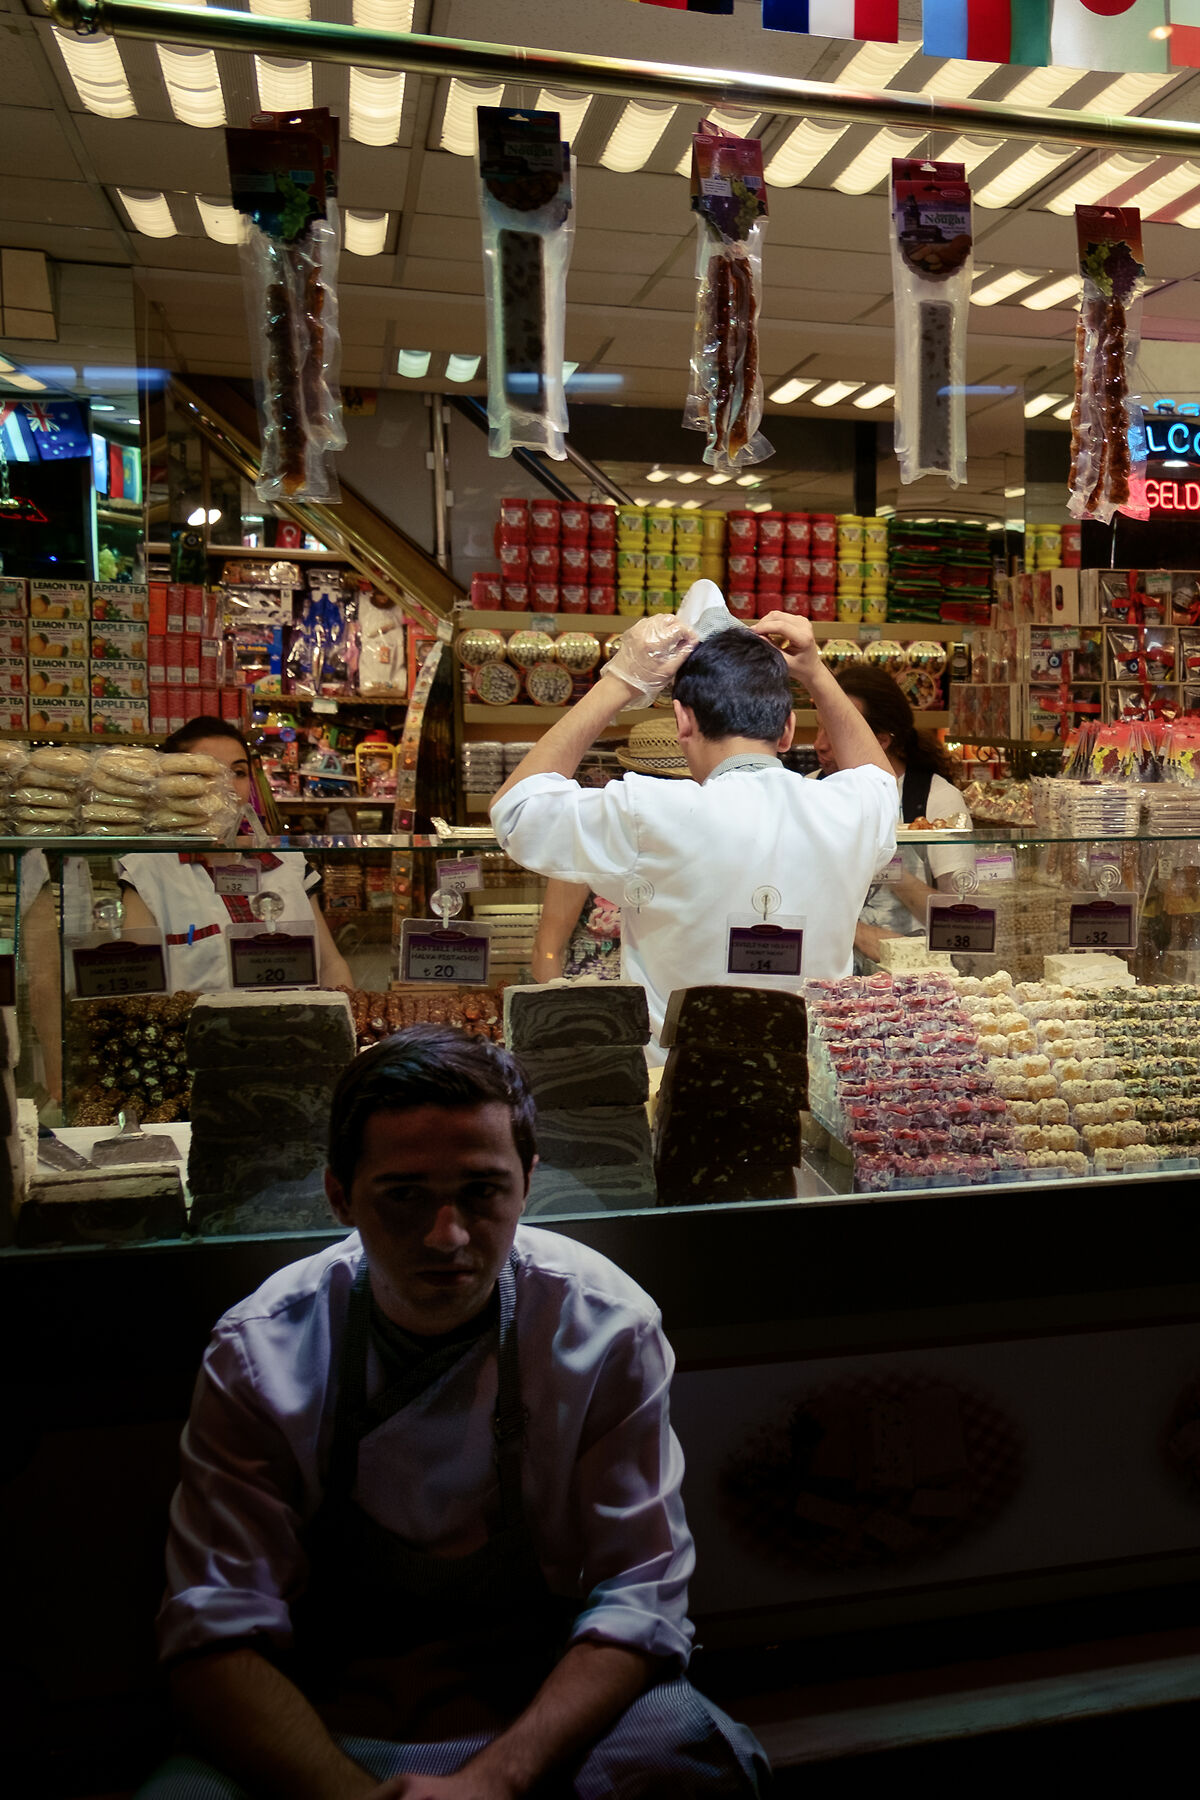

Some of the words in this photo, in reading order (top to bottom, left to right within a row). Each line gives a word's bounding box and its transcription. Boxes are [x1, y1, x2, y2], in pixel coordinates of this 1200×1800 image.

[924, 214, 966, 225] Nougat
[33, 582, 66, 590] LEMON
[69, 583, 85, 591] TEA
[94, 584, 126, 593] APPLE
[129, 585, 147, 594] TEA
[8, 620, 24, 628] TEA
[32, 621, 66, 629] LEMON
[68, 622, 85, 630] TEA
[93, 623, 124, 632] APPLE
[127, 624, 146, 633] TEA
[9, 658, 24, 666] TEA
[32, 660, 66, 668] LEMON
[69, 661, 85, 669] TEA
[92, 661, 124, 670] APPLE
[127, 663, 145, 671] TEA
[8, 697, 24, 705] TEA
[32, 698, 66, 707] LEMON
[69, 699, 85, 707] TEA
[93, 699, 125, 709] APPLE
[129, 701, 147, 709] TEA
[231, 883, 242, 892] 32
[455, 881, 466, 889] 20
[954, 935, 970, 948] 38
[1093, 931, 1108, 943] 32
[756, 959, 772, 970] 14
[264, 968, 286, 982] 20
[434, 964, 455, 978] 20
[109, 977, 129, 991] 13
